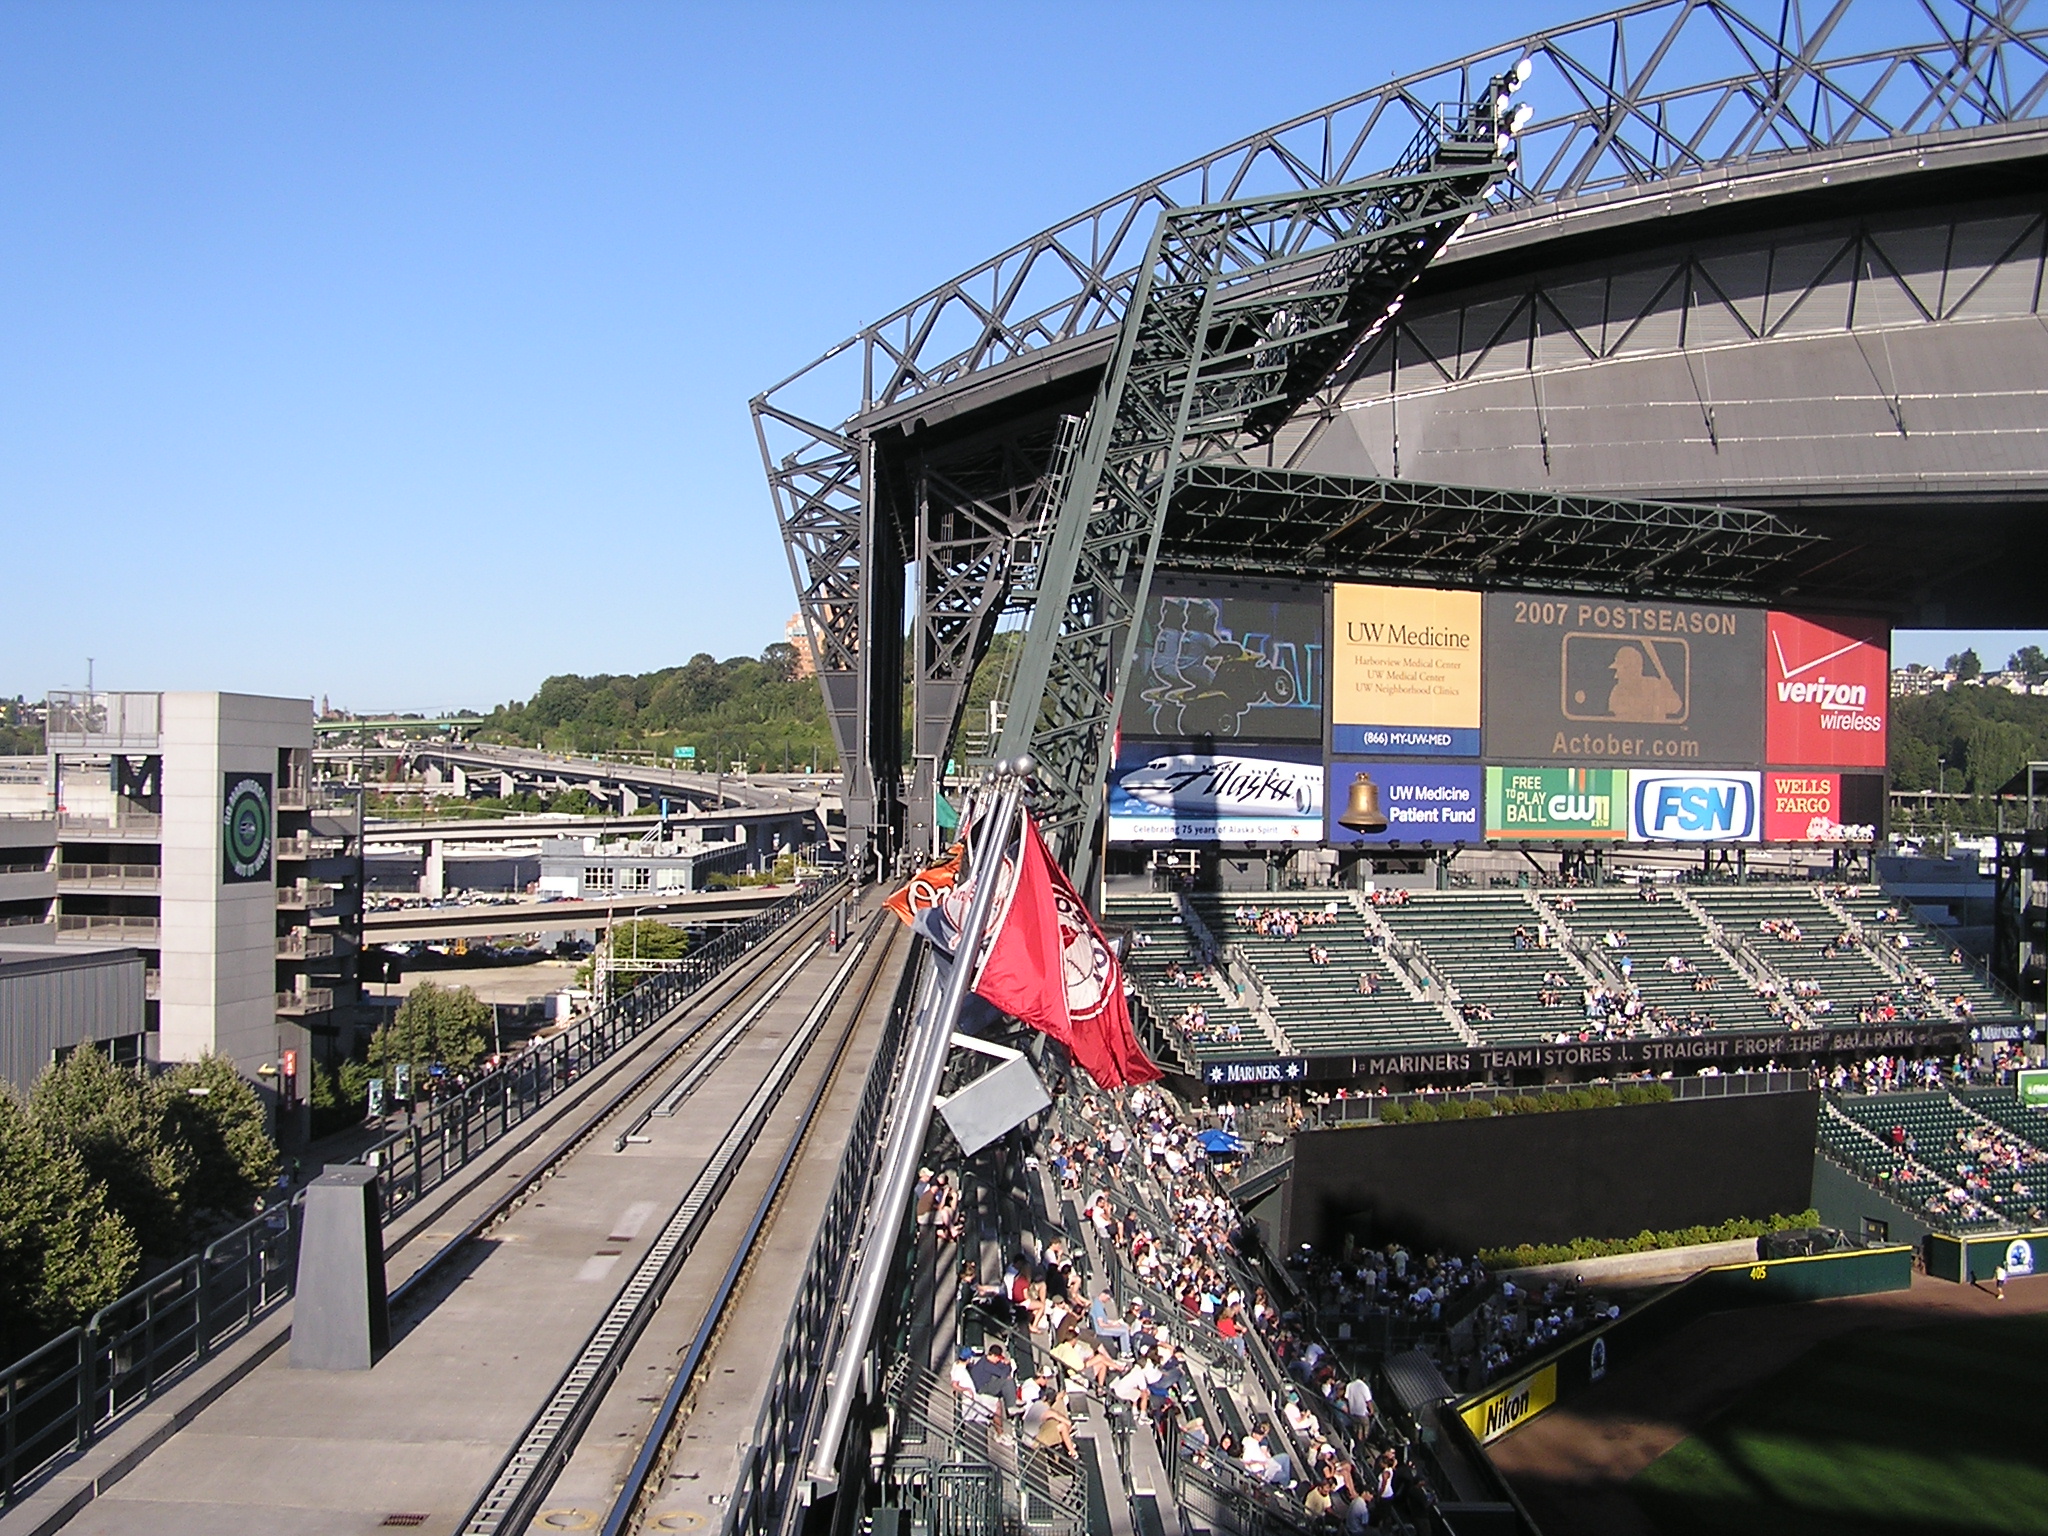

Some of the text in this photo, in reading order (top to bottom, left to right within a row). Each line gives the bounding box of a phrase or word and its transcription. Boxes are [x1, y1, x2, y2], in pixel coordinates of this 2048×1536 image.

[1515, 602, 1736, 636] 2007 POSTSEASON
[1347, 622, 1470, 647] UW Medicine
[1355, 655, 1461, 669] Harborview Medical Center
[1367, 670, 1445, 681] UW Medical Center
[1356, 683, 1459, 696] UW Neighborhood Clinics
[1777, 677, 1866, 711] verizon
[1820, 711, 1882, 732] wireless
[1364, 732, 1451, 746] (866) MY-UW-MED
[1552, 732, 1699, 757] Actober.com
[1165, 761, 1294, 803] Alaska
[1513, 776, 1541, 790] FREE
[1775, 779, 1831, 796] WELLS
[1389, 786, 1469, 802] UW Medicine
[1505, 789, 1546, 805] TO PLAY
[1507, 805, 1547, 822] BALL
[1654, 786, 1736, 832] FSN
[1776, 797, 1831, 814] FARGO
[1389, 808, 1475, 823] Patient Fund
[1133, 825, 1277, 836] Celebrating 75 years of Alaska Spirit
[1369, 1053, 1471, 1075] MARINERS
[1480, 1051, 1532, 1069] TEAM
[1544, 1047, 1612, 1066] STORES
[1642, 1041, 1728, 1060] STRAIGHT
[1734, 1038, 1782, 1054] FROM
[1790, 1035, 1821, 1051] THE
[1833, 1030, 1914, 1049] BALLPARK
[1228, 1064, 1281, 1081] MARINERS
[1750, 1265, 1766, 1280] 405
[1485, 1390, 1530, 1437] Nikon
